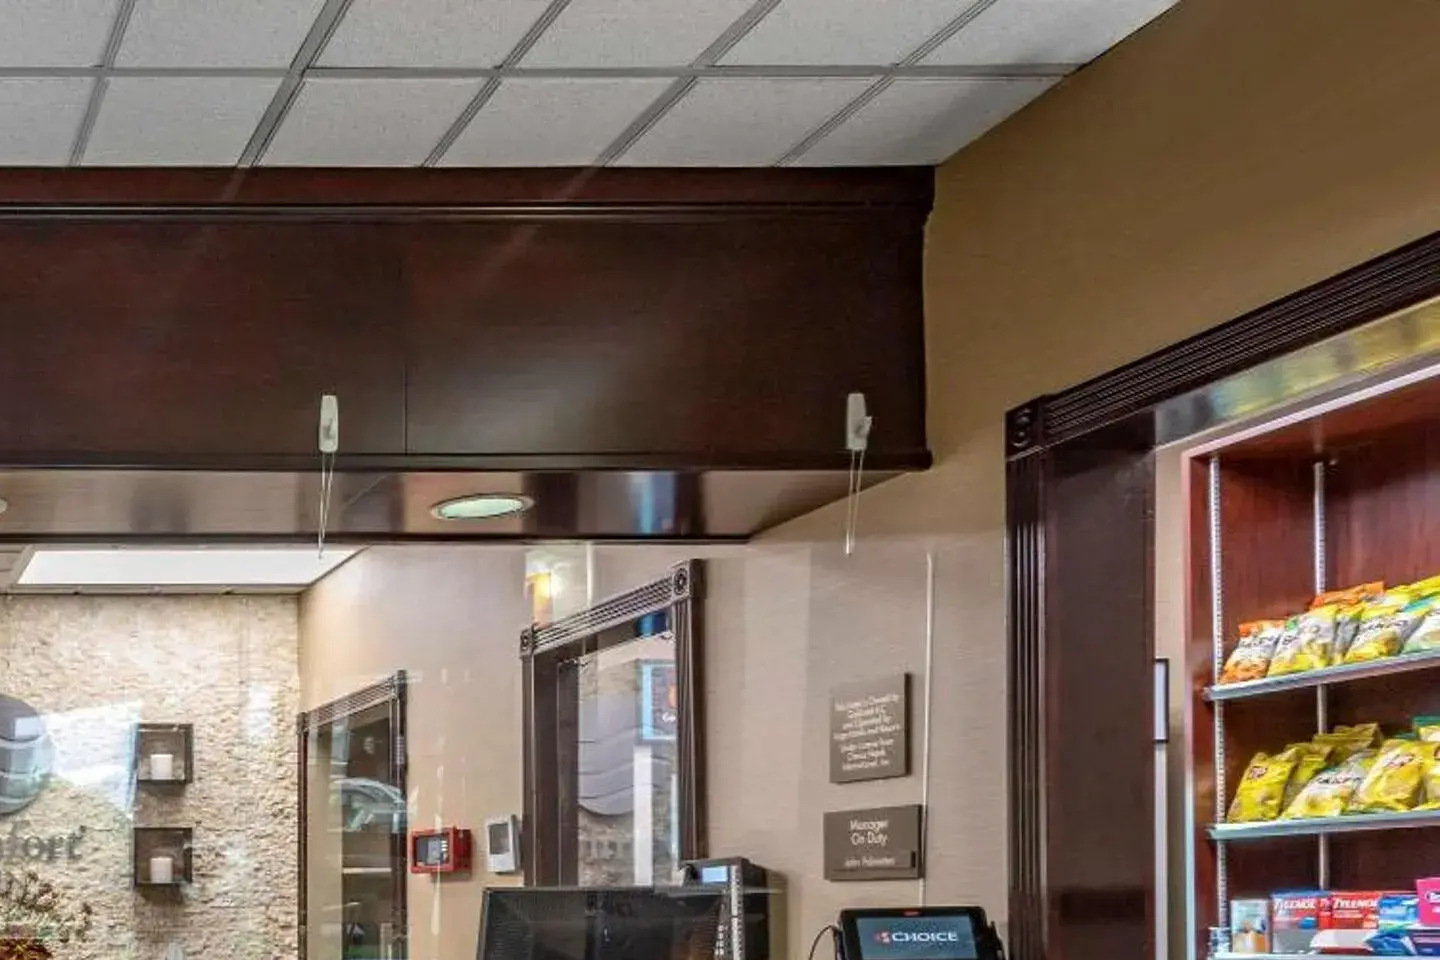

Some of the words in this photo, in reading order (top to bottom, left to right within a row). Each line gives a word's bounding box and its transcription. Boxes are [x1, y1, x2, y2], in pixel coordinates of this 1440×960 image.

[849, 820, 889, 834] Manager
[851, 833, 865, 846] On
[867, 831, 888, 847] Duty
[891, 931, 959, 942] CHOICE
